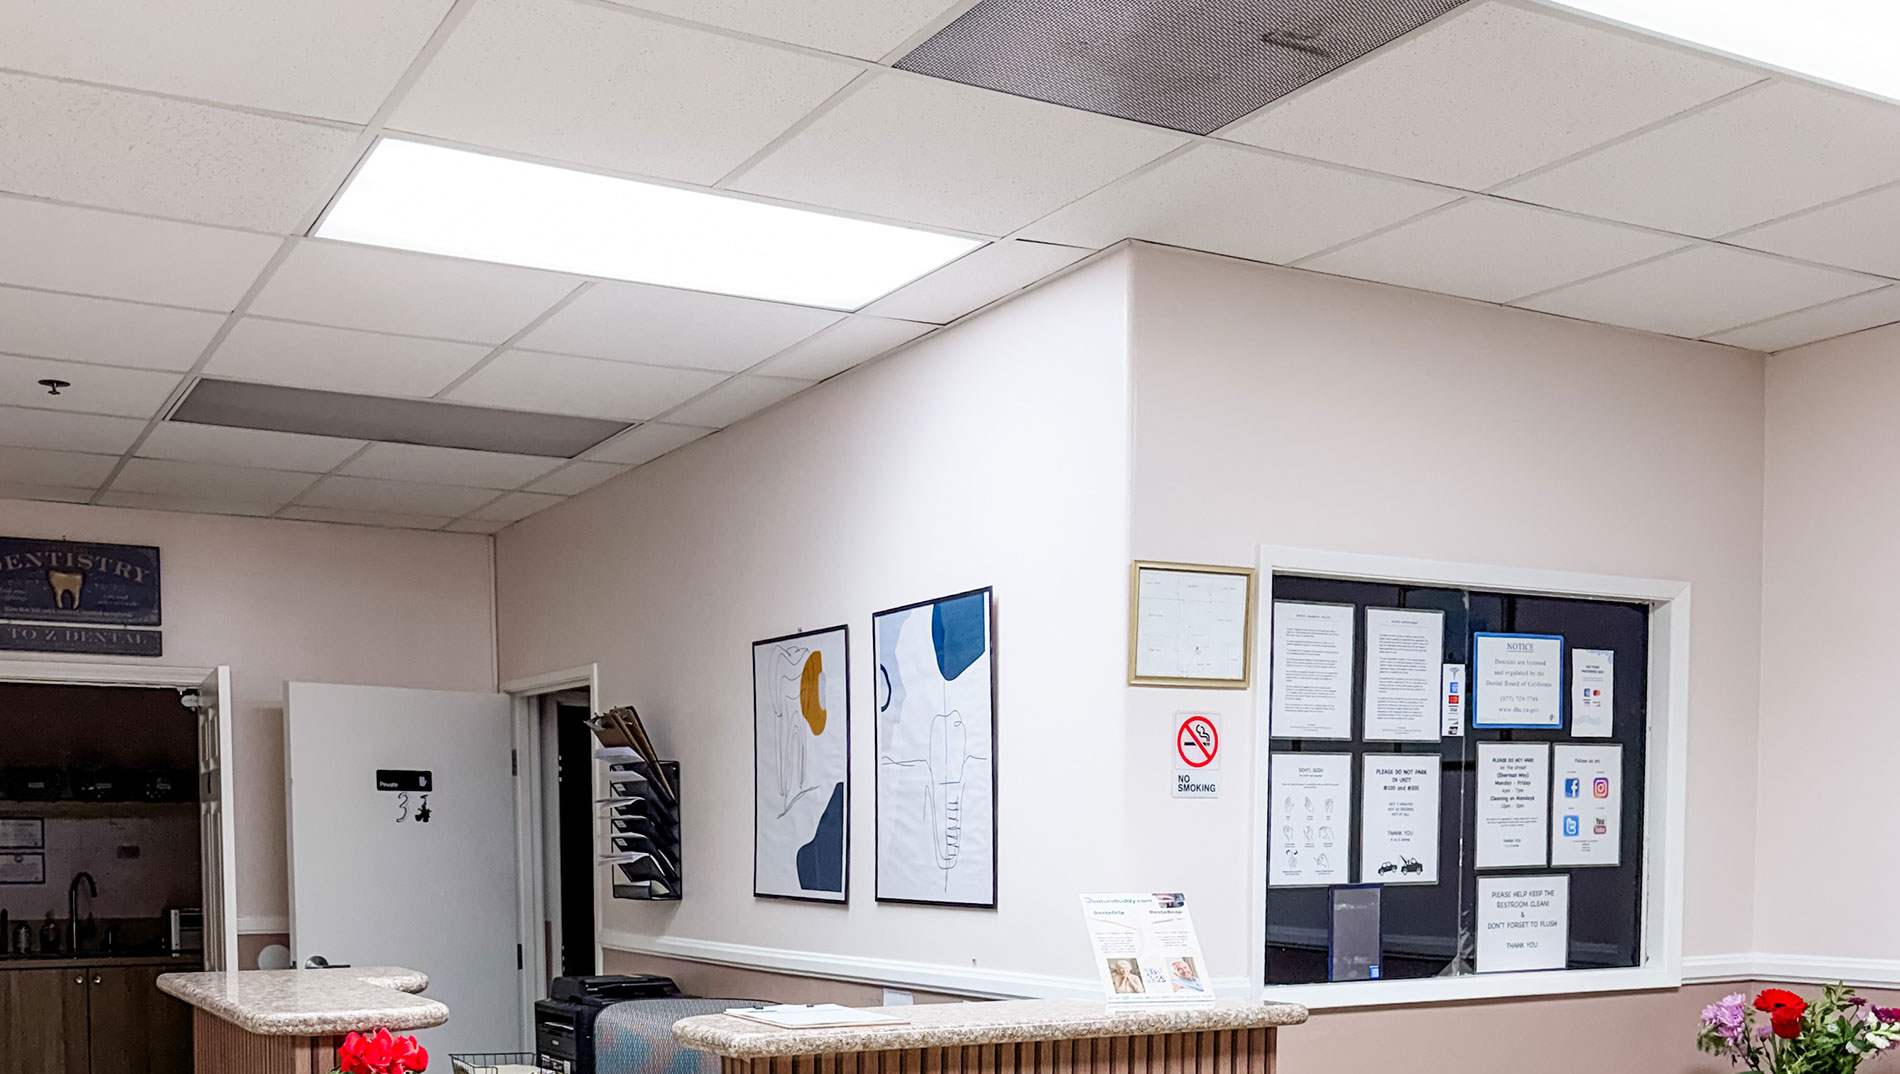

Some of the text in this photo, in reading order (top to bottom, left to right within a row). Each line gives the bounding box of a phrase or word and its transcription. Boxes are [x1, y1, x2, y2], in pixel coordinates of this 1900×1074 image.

[0, 552, 150, 583] ENTISTRY
[8, 628, 147, 645] TO Z DENTAL
[1507, 642, 1534, 651] NOTICE
[1178, 774, 1190, 783] NO
[1177, 783, 1216, 792] SMOKING
[396, 791, 408, 823] 3
[1596, 818, 1605, 826] You
[1491, 890, 1512, 898] PLEASE
[1513, 890, 1527, 898] HELP
[1497, 901, 1528, 909] RESTROOM
[1488, 922, 1505, 930] DON'T
[1507, 921, 1529, 929] FORGET
[1540, 920, 1558, 928] FLUSH
